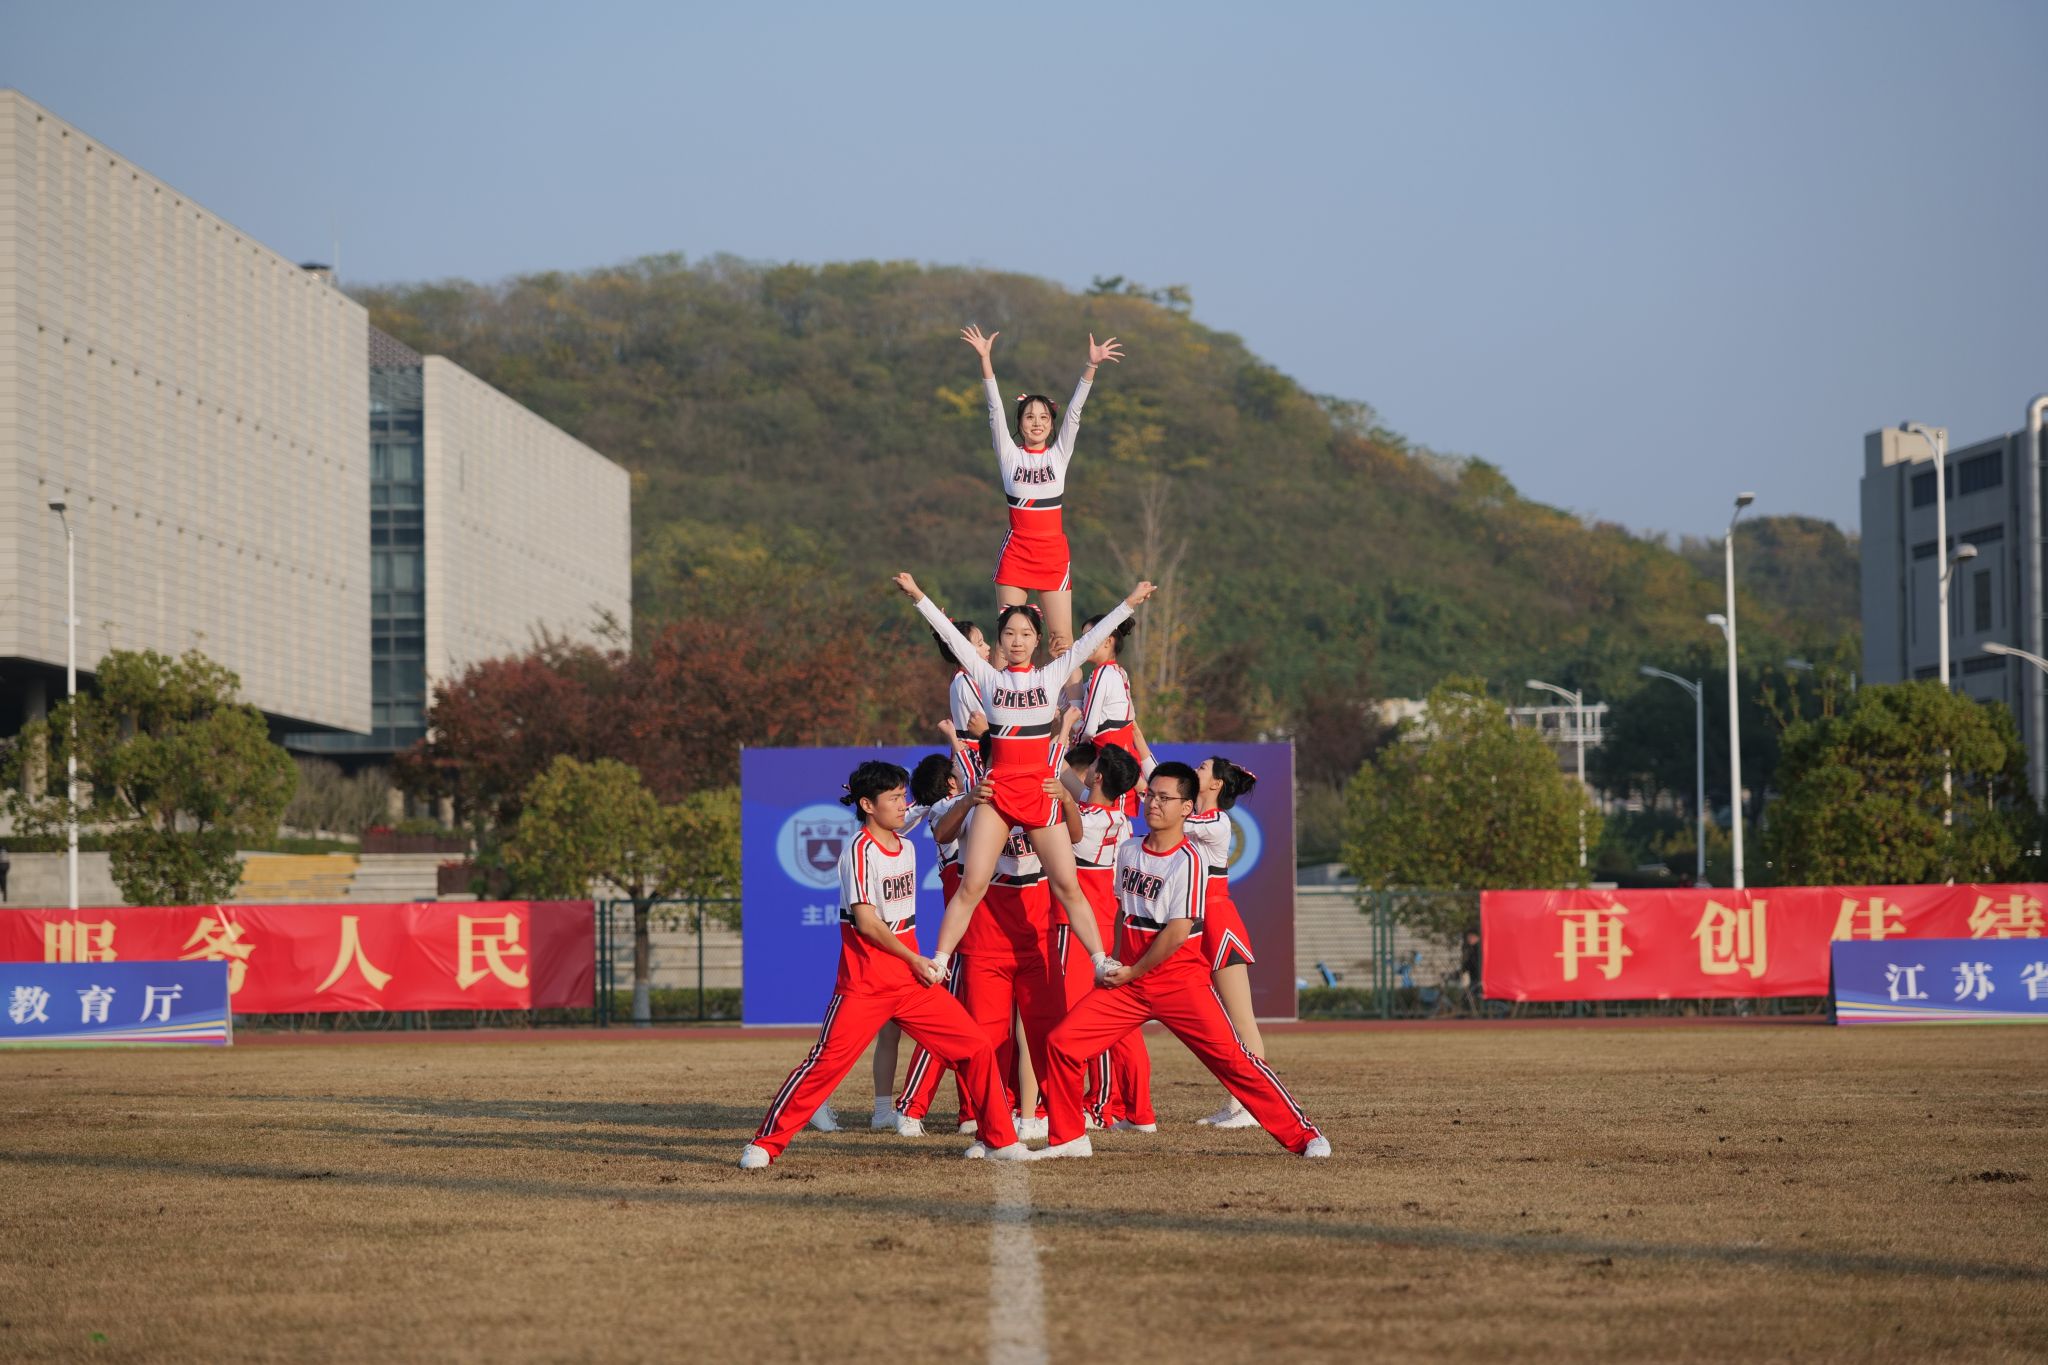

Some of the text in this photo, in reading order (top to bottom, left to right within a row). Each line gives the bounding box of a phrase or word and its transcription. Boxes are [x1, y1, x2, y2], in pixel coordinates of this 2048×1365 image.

[1013, 464, 1056, 485] CHEER
[992, 686, 1049, 709] CHEER
[882, 871, 914, 903] CHEE
[1122, 865, 1165, 902] CHEER
[8, 983, 184, 1025] 教育厅
